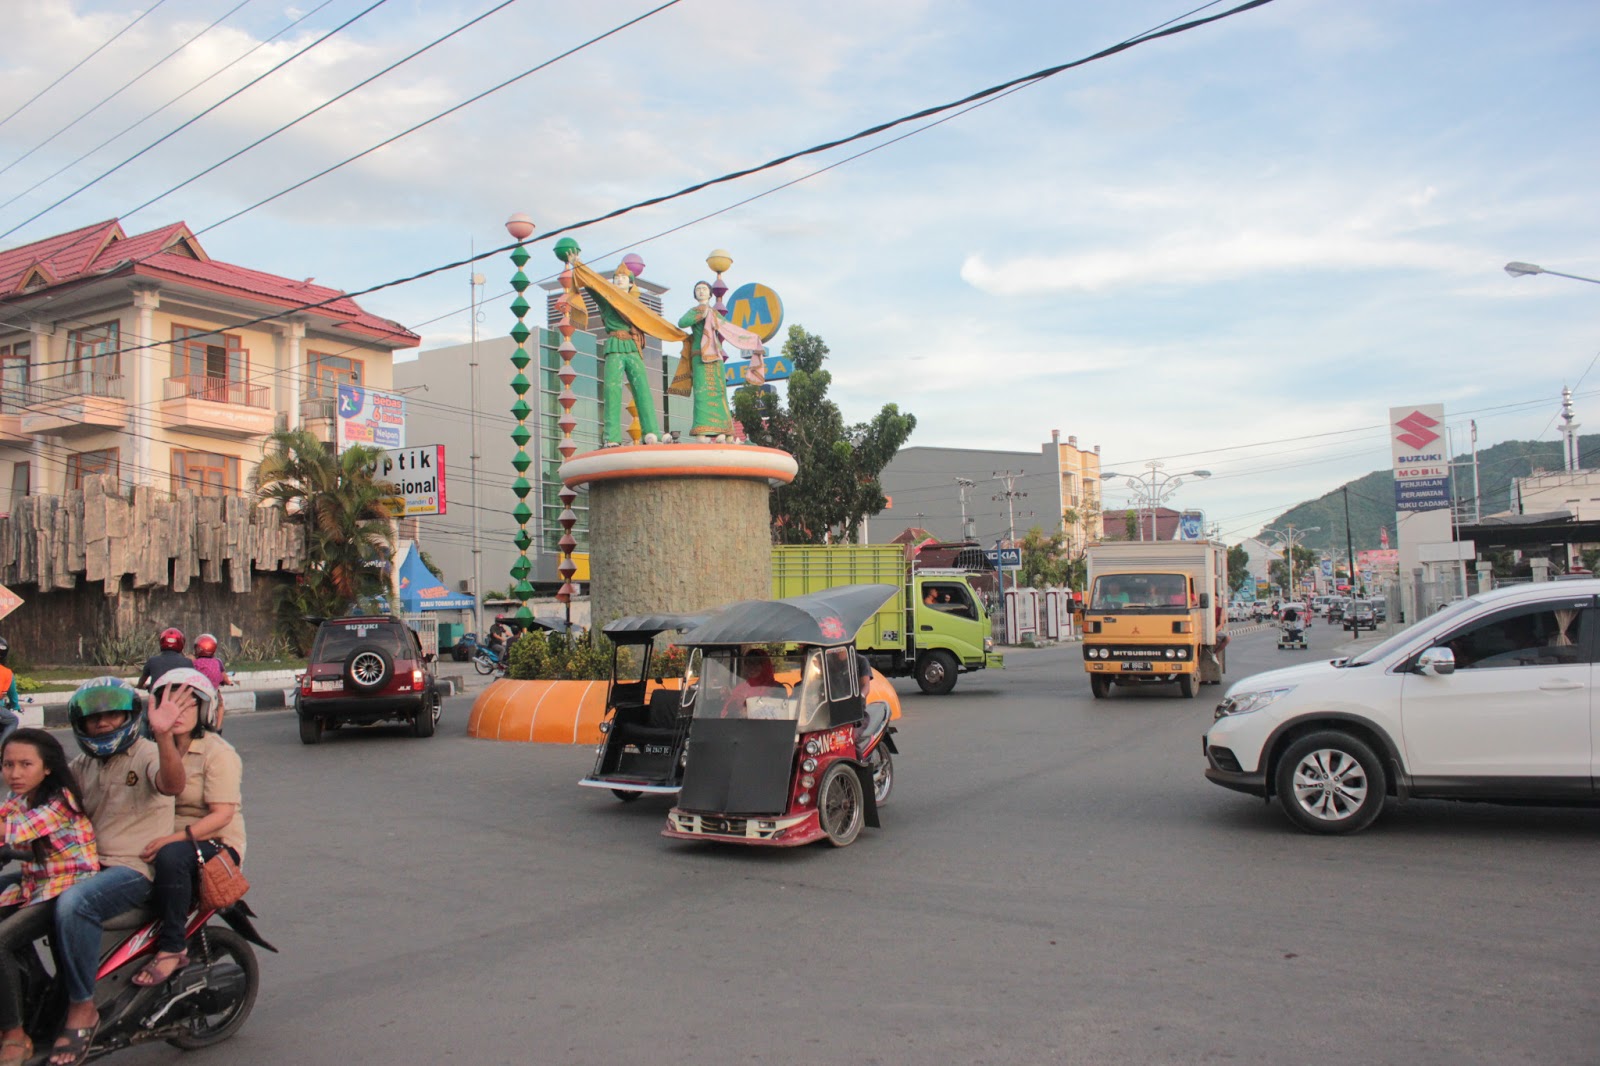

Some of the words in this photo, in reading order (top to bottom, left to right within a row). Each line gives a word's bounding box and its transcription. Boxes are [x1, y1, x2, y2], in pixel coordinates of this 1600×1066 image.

[373, 393, 402, 408] Bebas
[373, 406, 381, 421] 6
[382, 413, 403, 425] Bulan
[1398, 454, 1442, 463] SUZUKI
[1398, 468, 1443, 477] MOBIL
[394, 476, 436, 496] sional
[1400, 480, 1443, 488] PENJUALAN
[1401, 490, 1444, 499] PERAWATAN
[1419, 500, 1449, 508] CADANG
[985, 551, 1018, 560] NOKIA
